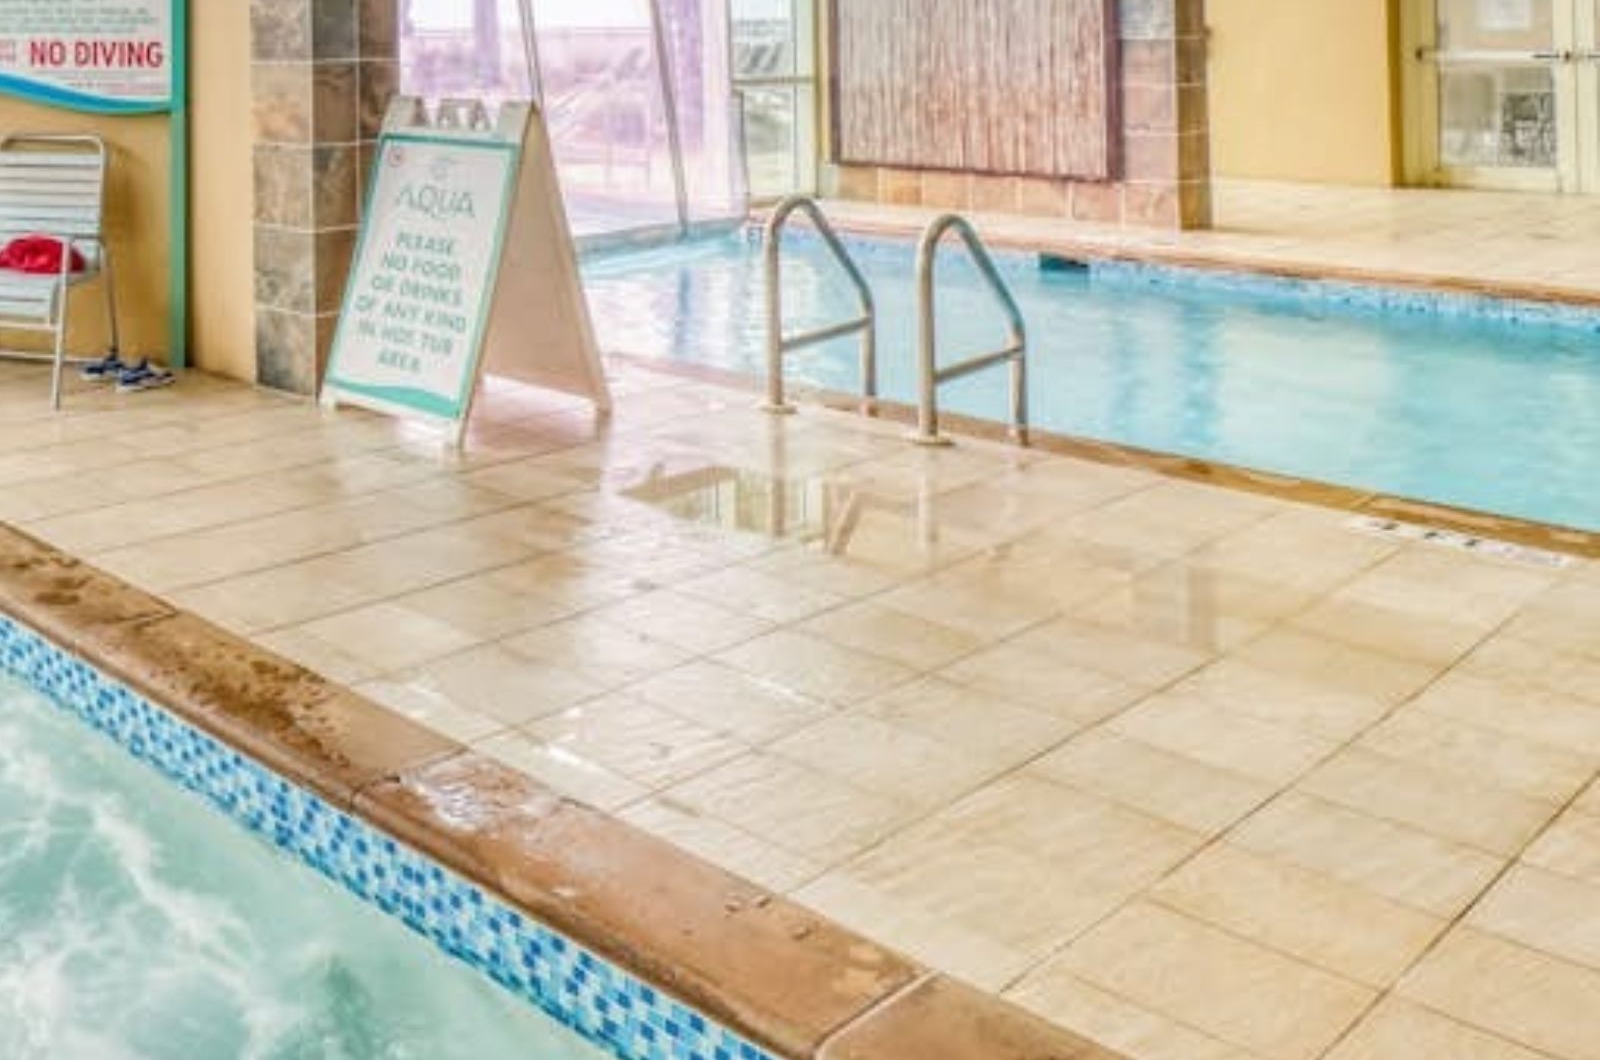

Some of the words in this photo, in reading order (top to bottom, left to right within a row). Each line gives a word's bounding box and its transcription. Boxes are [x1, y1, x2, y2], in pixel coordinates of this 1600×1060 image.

[29, 40, 66, 66] NO
[74, 40, 164, 68] DIVING
[395, 183, 476, 221] AQUA
[396, 231, 455, 255] PLEASE
[381, 252, 406, 272] NO
[411, 256, 462, 281] FOOD
[399, 278, 463, 307] DRINKS
[384, 300, 418, 323] ANY
[423, 308, 467, 333] KIND
[377, 349, 422, 374] AREA
